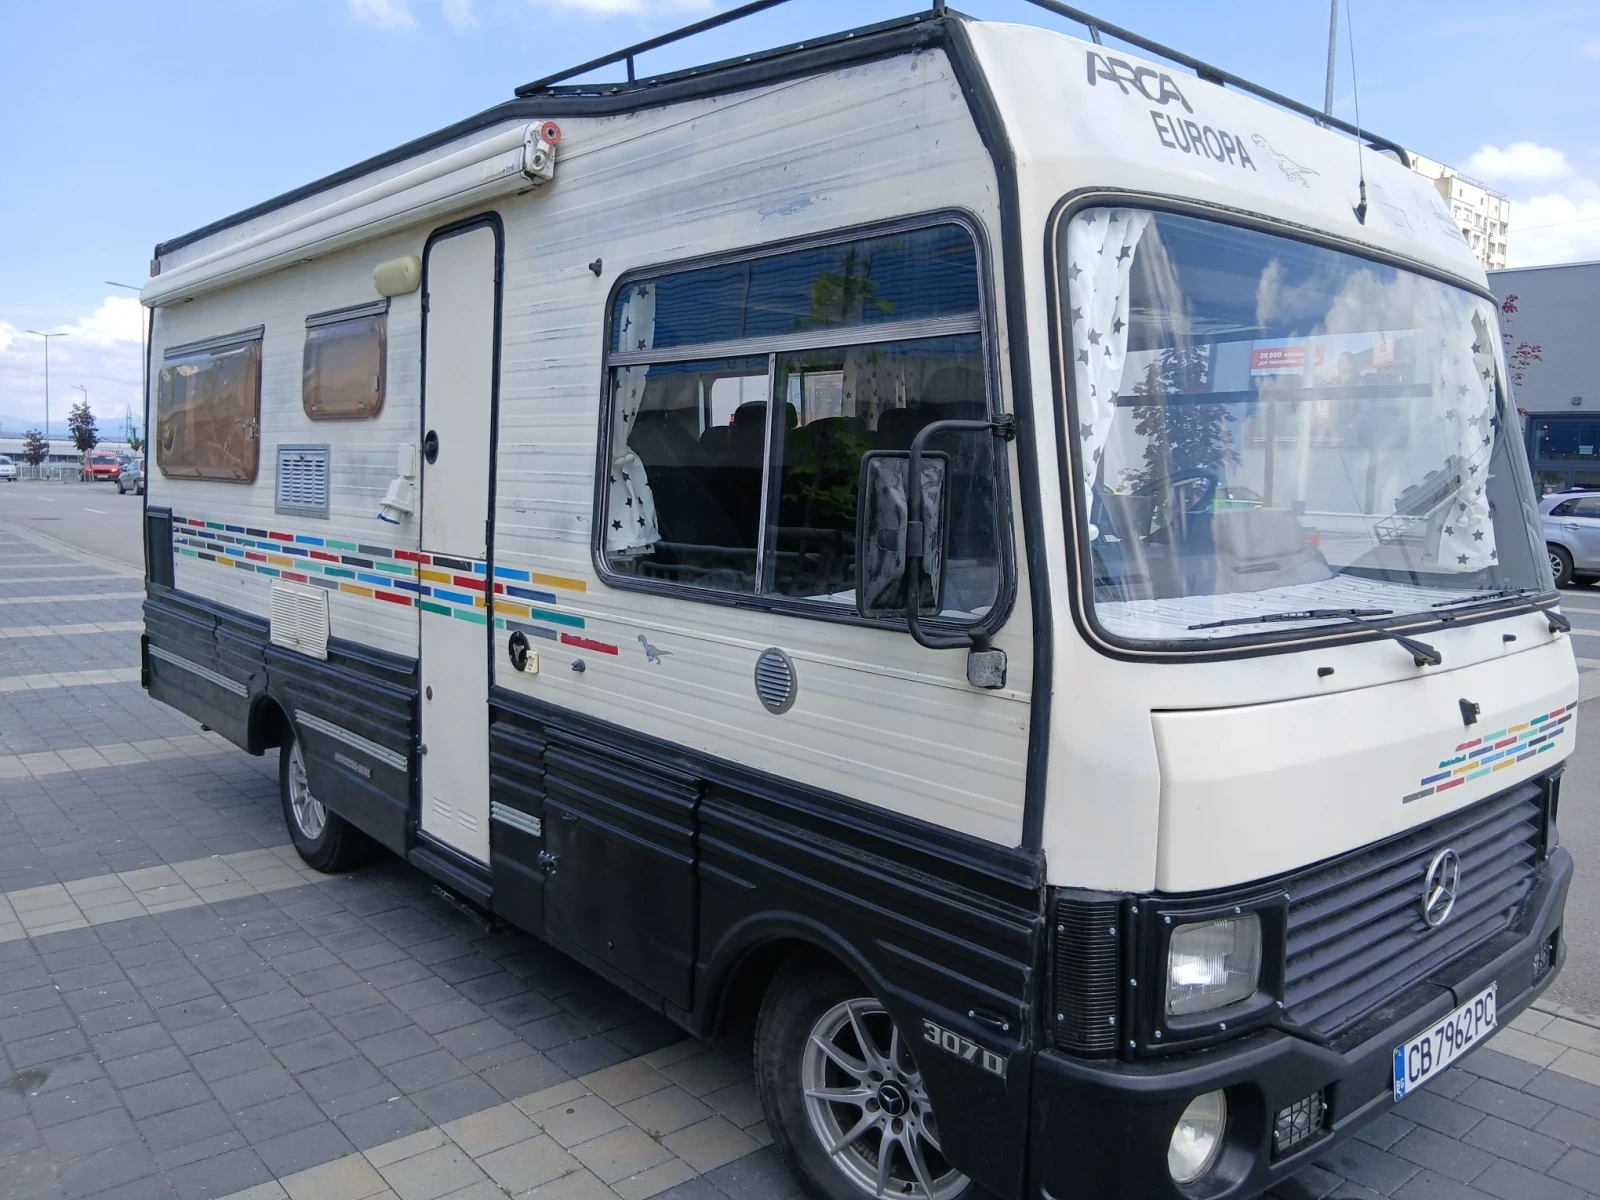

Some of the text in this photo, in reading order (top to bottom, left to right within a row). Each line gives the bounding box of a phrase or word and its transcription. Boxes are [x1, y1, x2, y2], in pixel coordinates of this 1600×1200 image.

[1086, 50, 1194, 114] ARCA
[1149, 109, 1258, 172] EUROPA
[923, 1022, 979, 1060] 307
